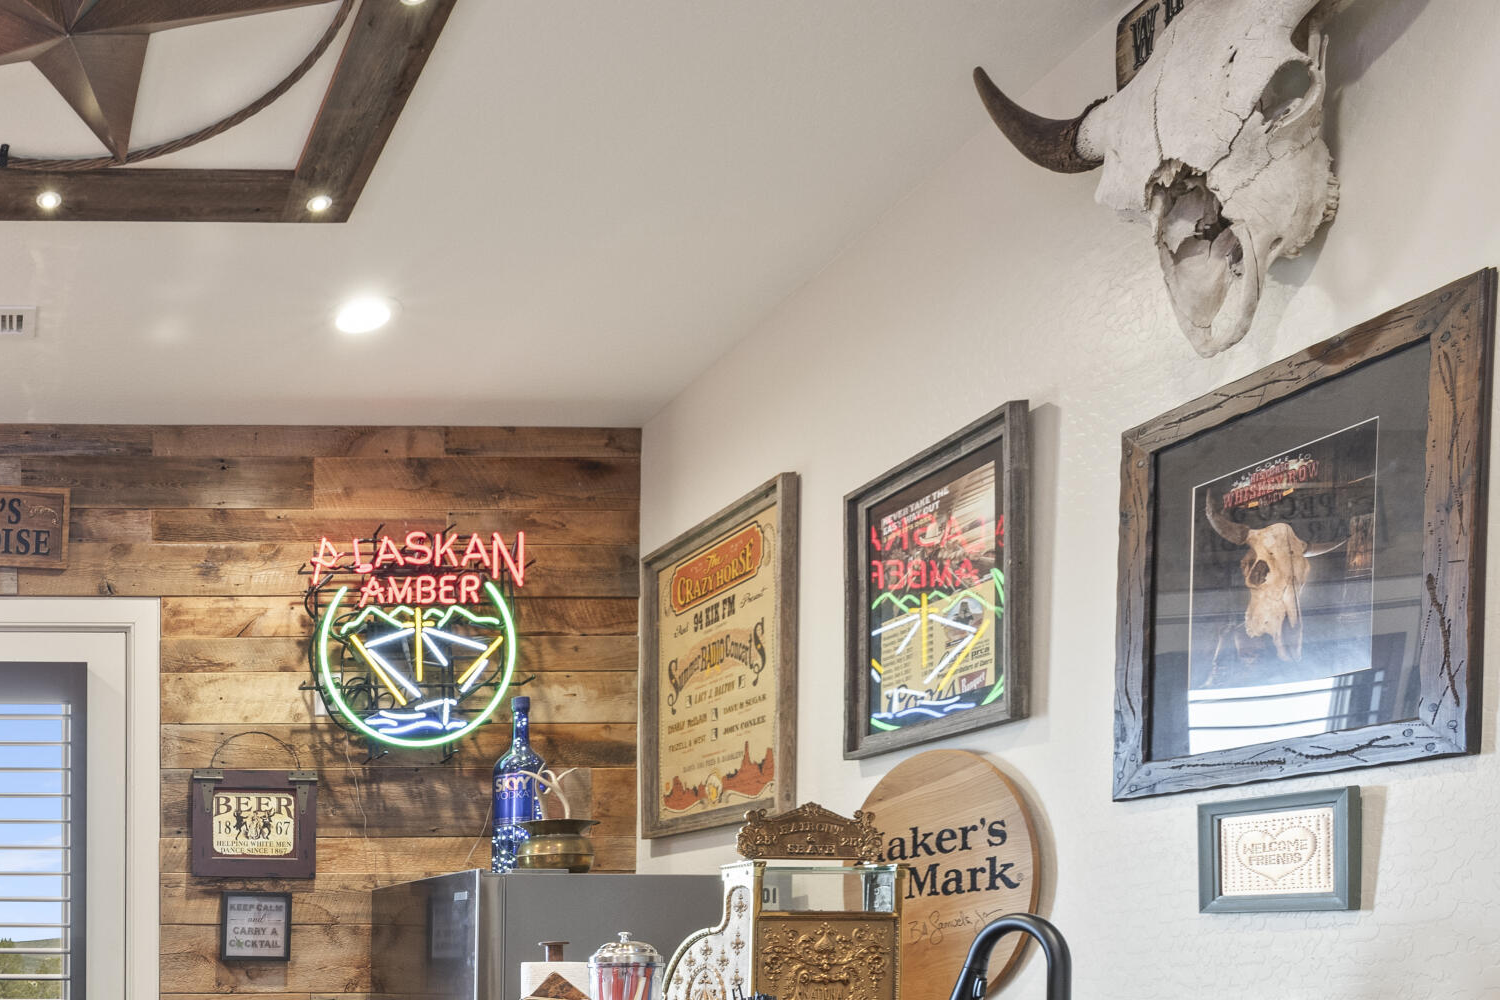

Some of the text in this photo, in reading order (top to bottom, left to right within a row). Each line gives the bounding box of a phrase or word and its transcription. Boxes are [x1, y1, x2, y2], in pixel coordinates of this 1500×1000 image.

[932, 486, 950, 501] THE
[1223, 460, 1320, 509] WHISKEY ROW
[310, 530, 525, 587] ALASKAN
[704, 552, 720, 574] The
[677, 540, 754, 606] CRAZY HORSE
[359, 574, 481, 608] AMBER
[496, 775, 531, 792] SKYY
[214, 796, 294, 819] BEER
[218, 820, 291, 836] 18 67
[250, 840, 274, 848] WHITE
[276, 840, 292, 848] MEN
[855, 818, 1007, 865] aker's
[1243, 838, 1309, 855] WELCOME
[1248, 852, 1302, 866] FRIENDS
[905, 856, 1021, 899] Mark
[229, 903, 255, 912] KEEP
[233, 926, 279, 936] CARRY A
